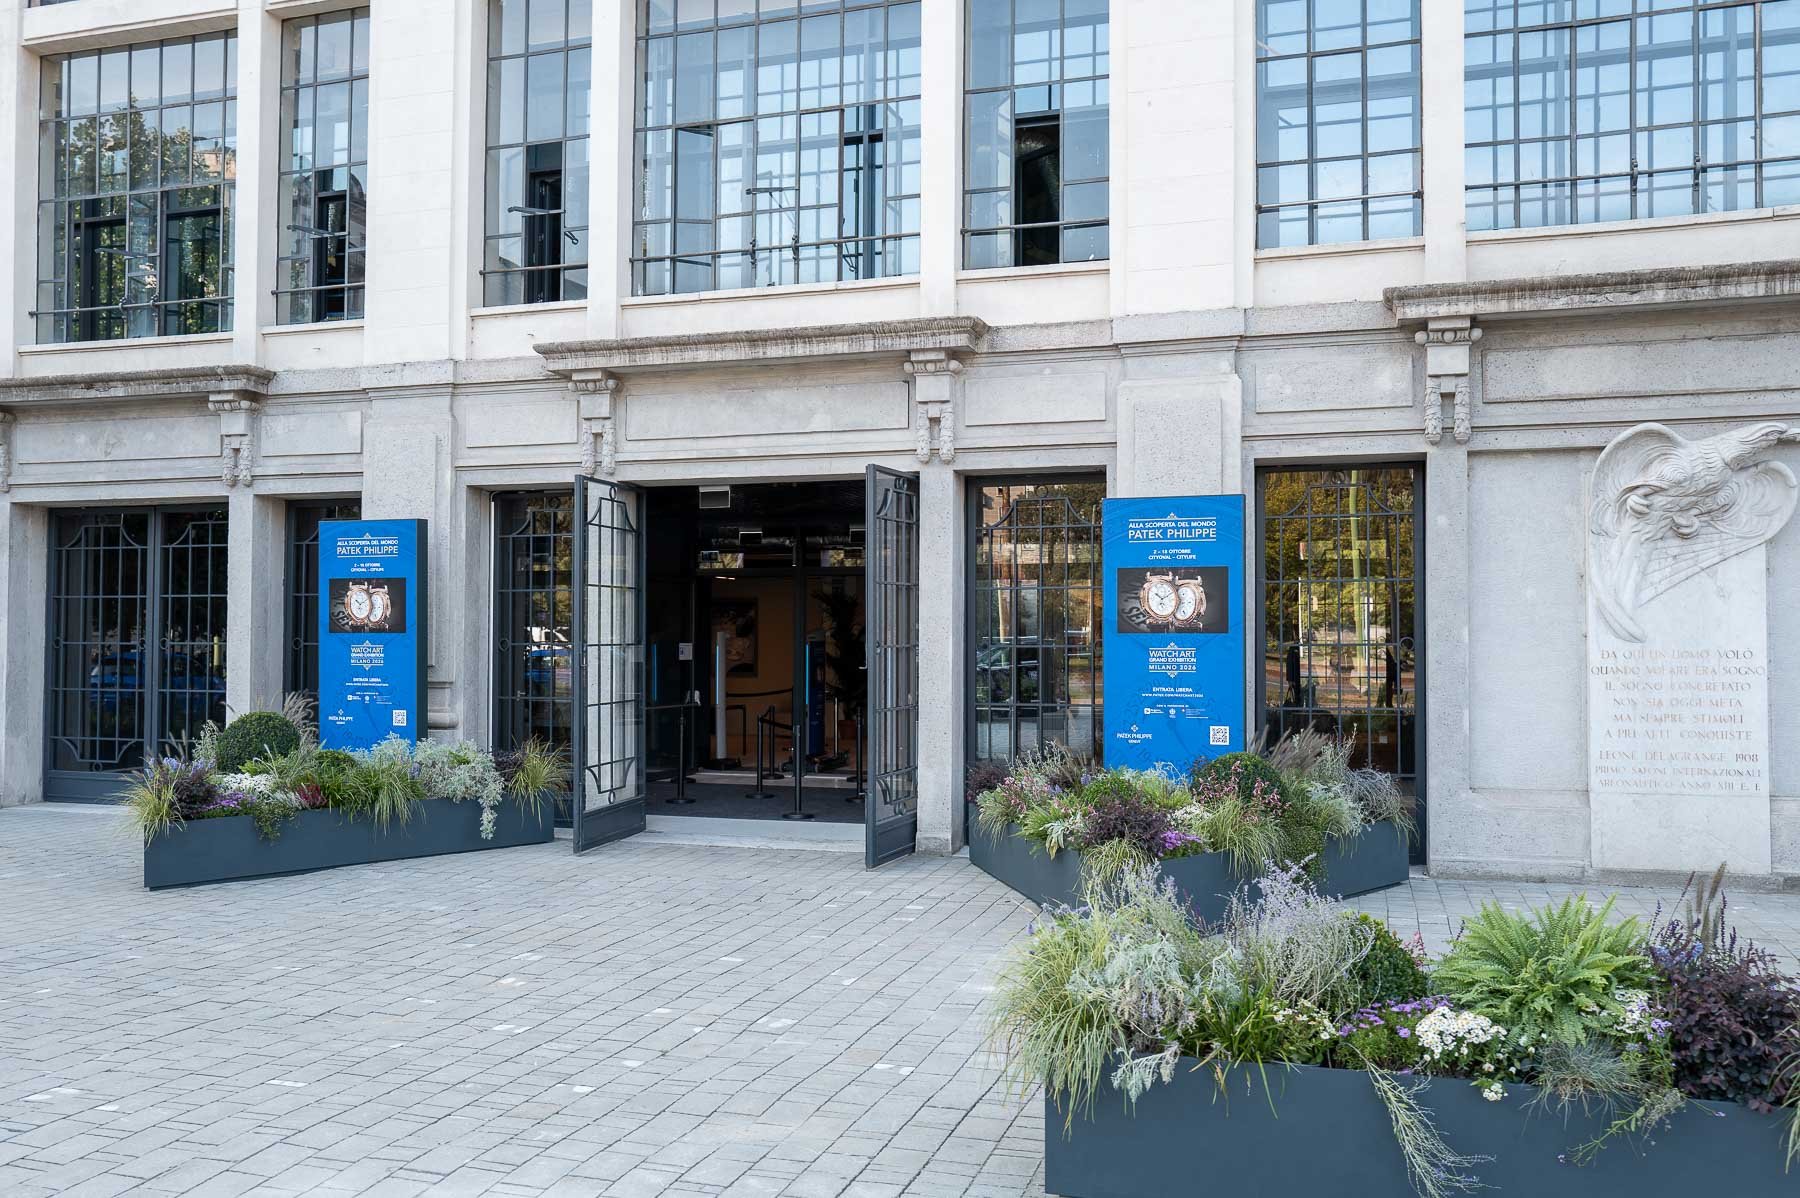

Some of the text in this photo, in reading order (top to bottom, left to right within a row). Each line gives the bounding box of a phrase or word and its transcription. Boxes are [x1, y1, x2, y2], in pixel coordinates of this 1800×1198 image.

[1128, 528, 1216, 539] PATEK PHILIPPE
[337, 546, 398, 555] PATEK PHILIPPE
[1600, 649, 1618, 660] DA
[1622, 648, 1645, 660] QUI
[1590, 665, 1641, 676] QUANDO
[1695, 666, 1718, 676] ERA
[1722, 665, 1766, 676] SOGNO
[1604, 681, 1617, 691] IL
[1620, 681, 1663, 691] SOGNO
[1613, 697, 1637, 706] NON
[1646, 697, 1663, 707] SIA
[1709, 698, 1743, 707] META
[1613, 713, 1633, 723] MA
[1693, 713, 1744, 724] STIMOLI
[1604, 728, 1612, 739] A
[1679, 730, 1753, 741] CONQUISTE
[1735, 752, 1759, 763] 1908
[1595, 765, 1626, 775] PRIMO
[1680, 781, 1712, 790] ANNO
